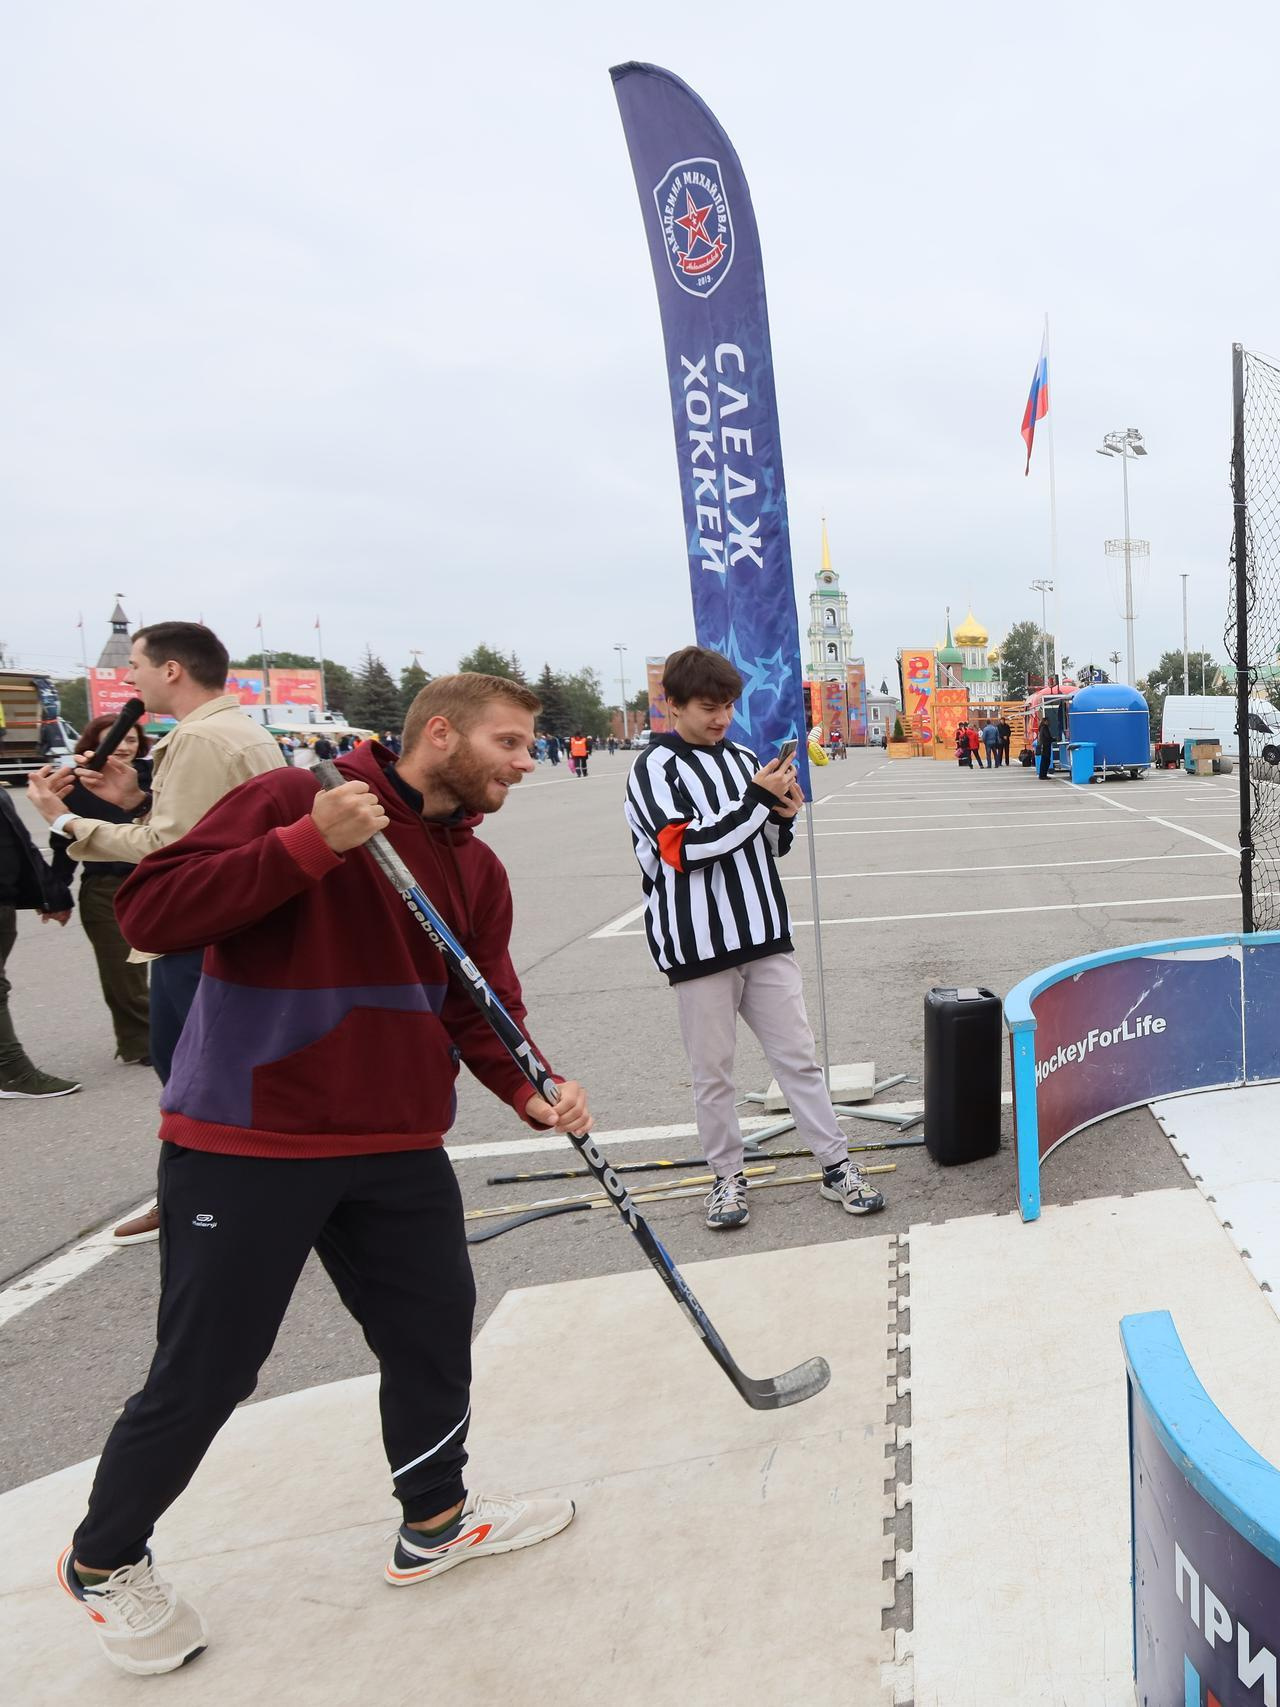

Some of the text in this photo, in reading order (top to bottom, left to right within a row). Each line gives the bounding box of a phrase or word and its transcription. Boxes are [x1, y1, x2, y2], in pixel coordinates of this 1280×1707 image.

[664, 172, 727, 254] АКАДЕМИЯ МИХАЙЛОВА
[680, 354, 730, 574] ХОККЕЙ
[714, 342, 763, 569] СЛЕДЖ
[401, 889, 448, 954] Reebok
[514, 1040, 639, 1232] Rebok
